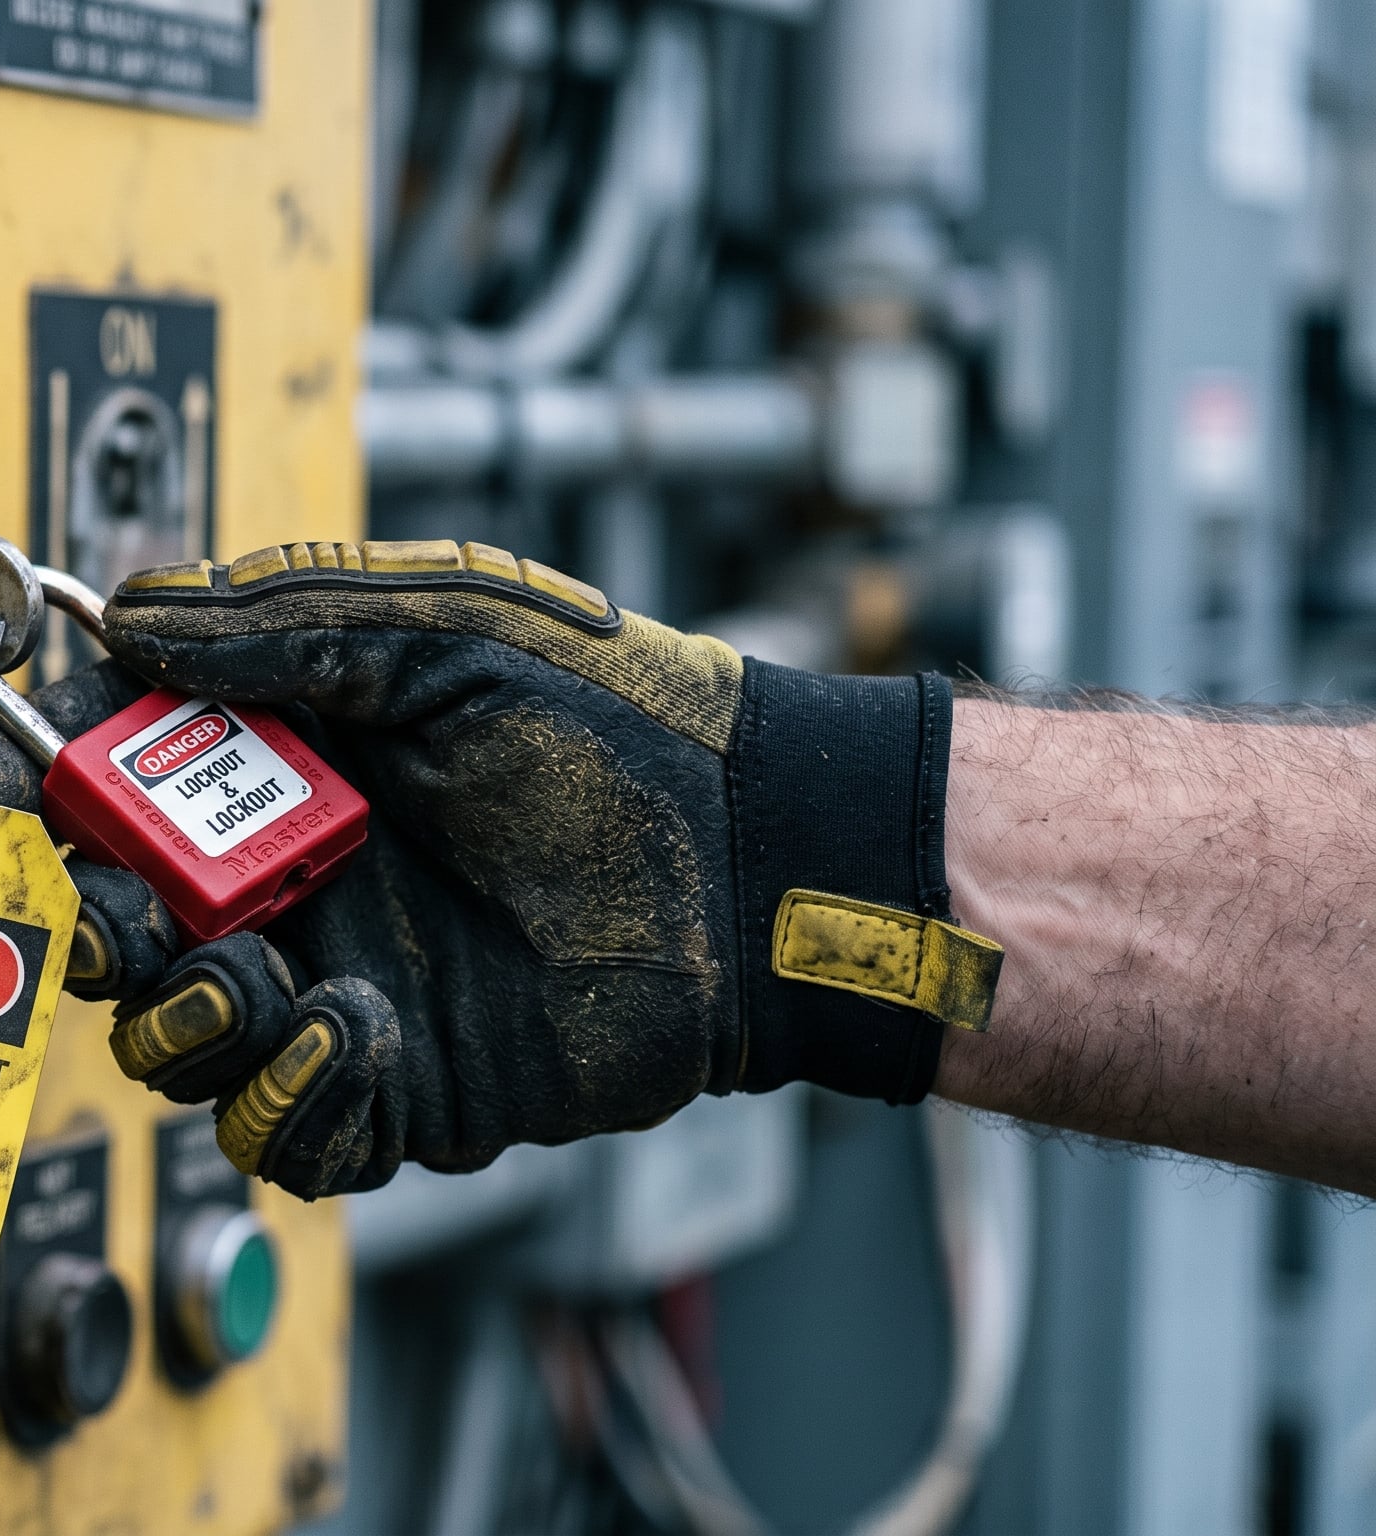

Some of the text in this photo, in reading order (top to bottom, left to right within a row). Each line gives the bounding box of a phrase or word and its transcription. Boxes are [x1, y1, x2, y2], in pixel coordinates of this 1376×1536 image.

[143, 719, 222, 773] DANGER
[175, 749, 247, 800] LOCKOUT
[218, 781, 240, 798] &
[205, 777, 286, 836] LOCKOUT
[222, 801, 334, 879] Master
